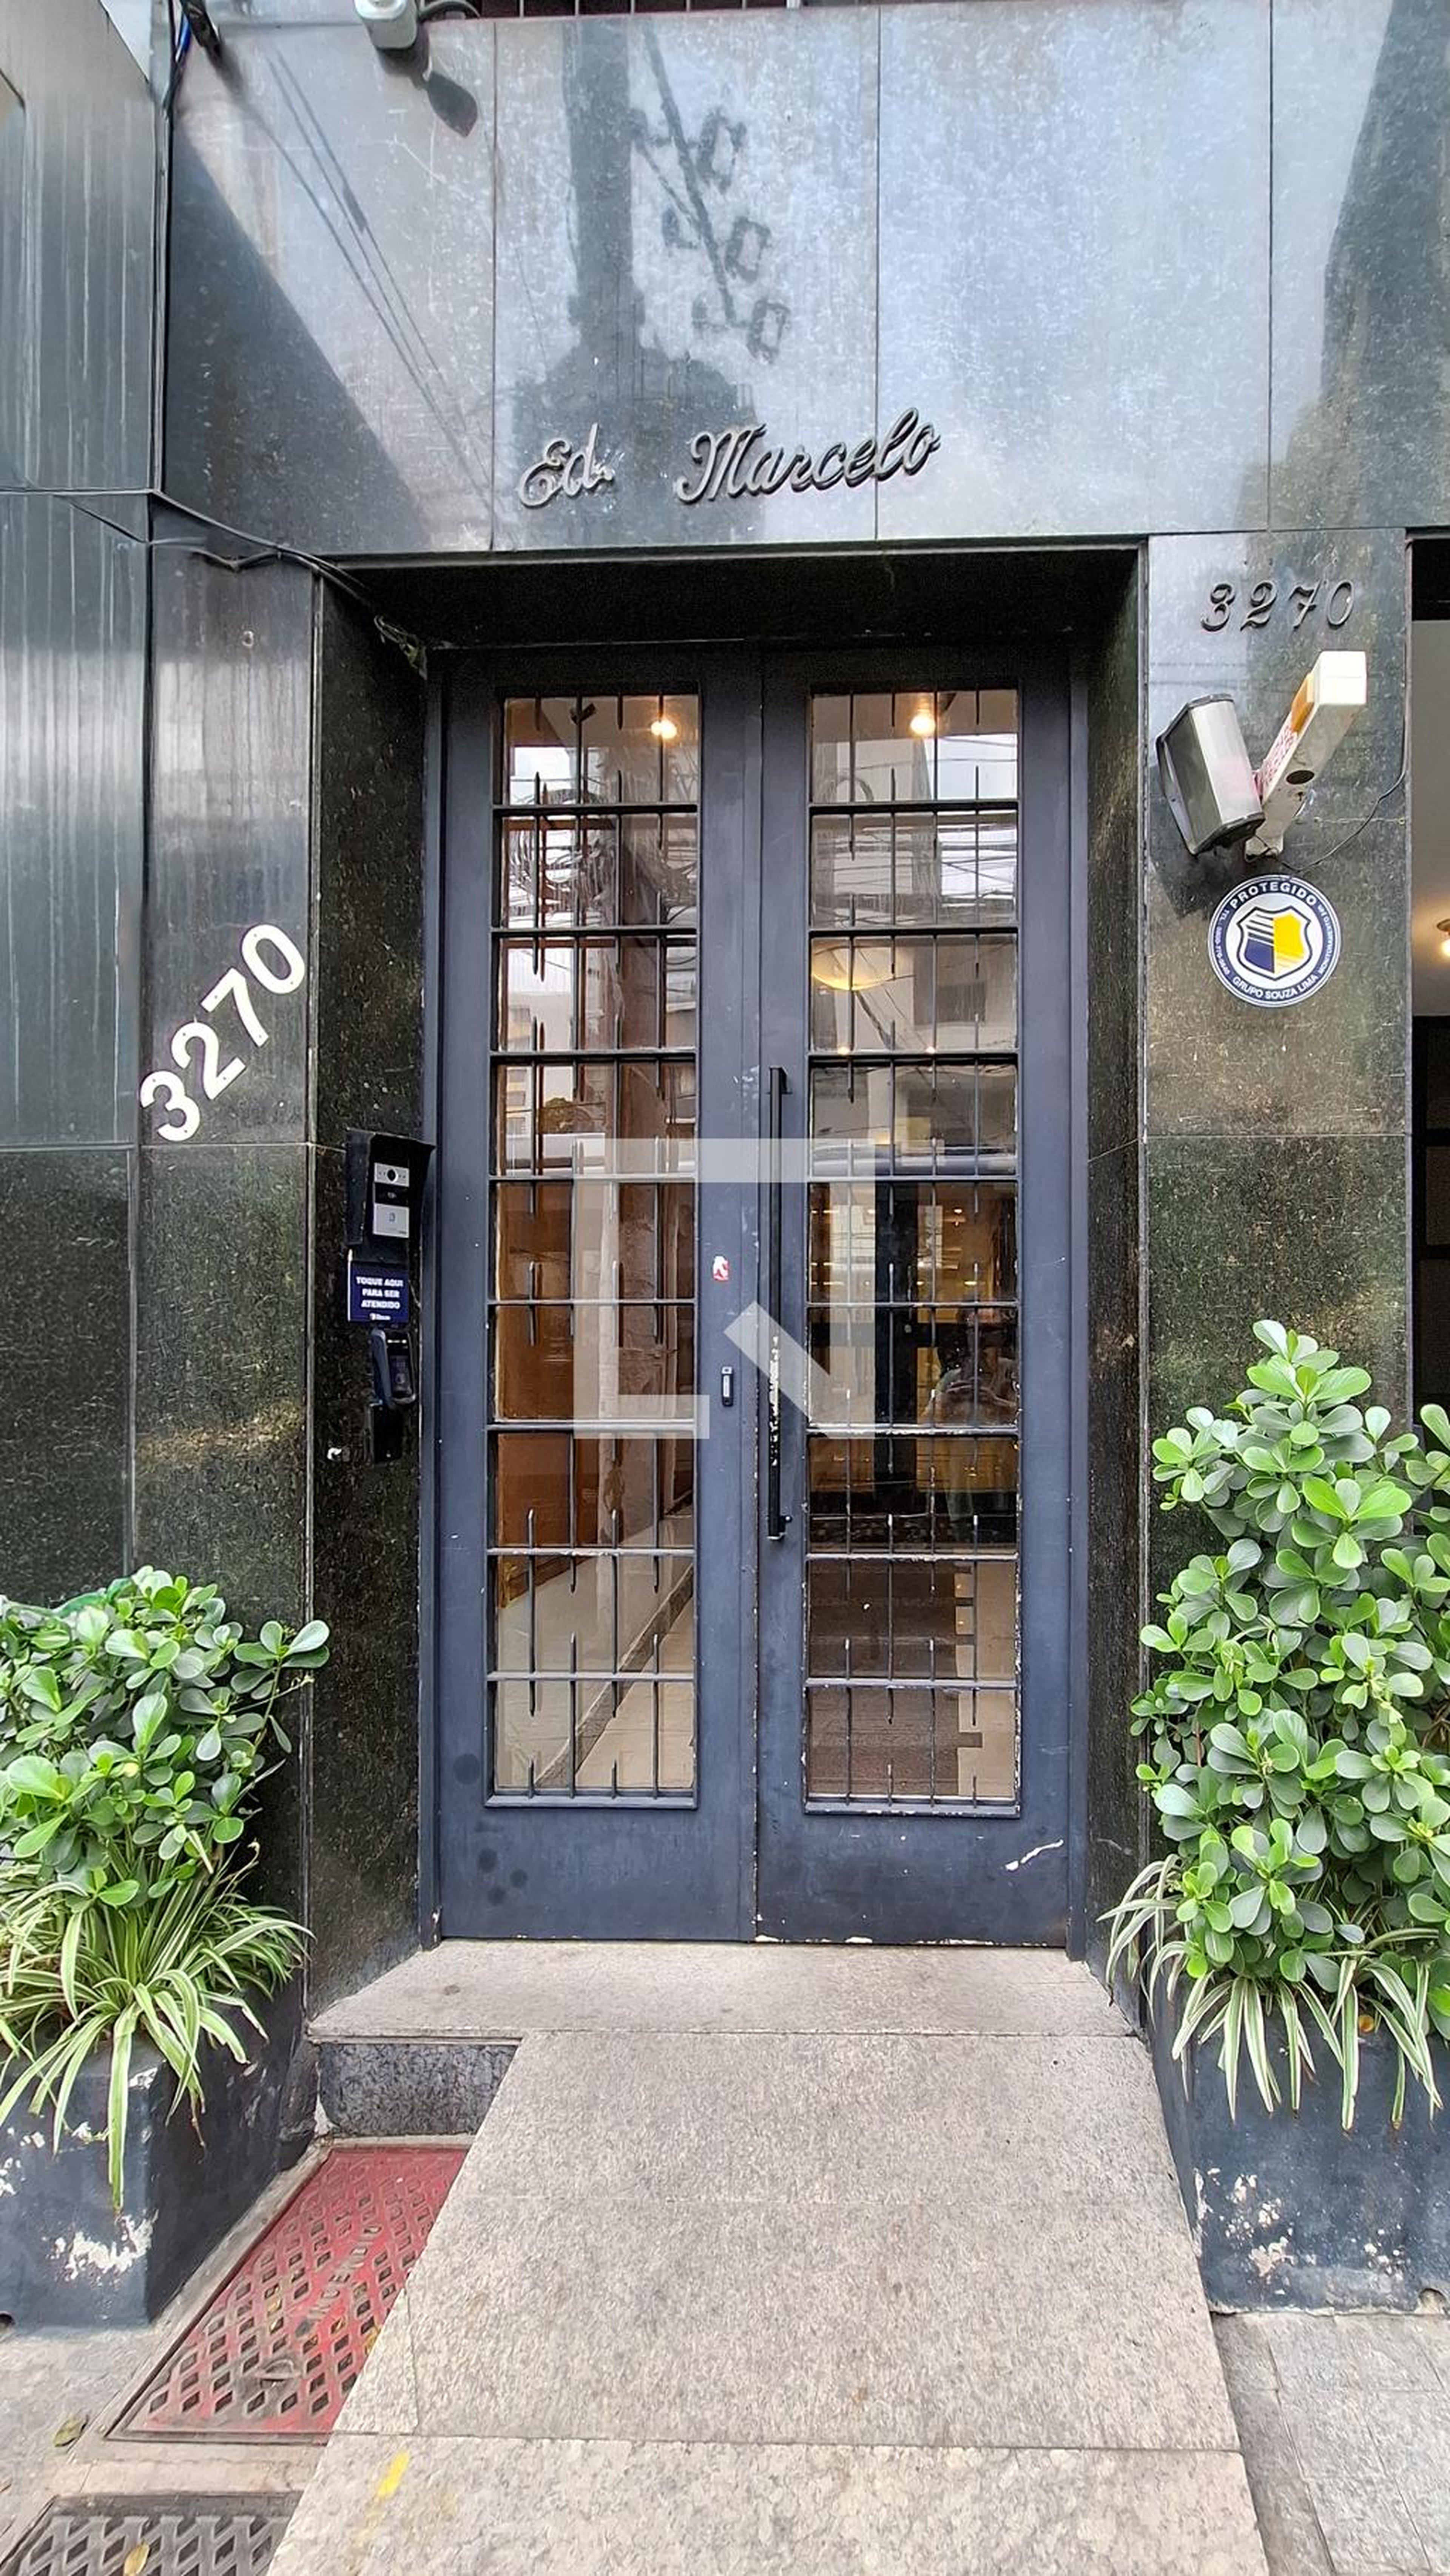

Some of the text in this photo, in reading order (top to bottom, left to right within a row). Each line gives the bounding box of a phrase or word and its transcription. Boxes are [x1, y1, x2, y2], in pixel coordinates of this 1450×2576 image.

[675, 406, 940, 503] Marcelo
[1201, 580, 1356, 631] 3270
[1229, 881, 1317, 909] PROTEGIDO
[1232, 975, 1319, 1000] GRUPO SOUZA LIMA
[140, 924, 305, 1142] 3270
[356, 1276, 403, 1287] TOQUE AQUI
[362, 1288, 400, 1298] PARA SER
[361, 1300, 401, 1309] ATENDIDO
